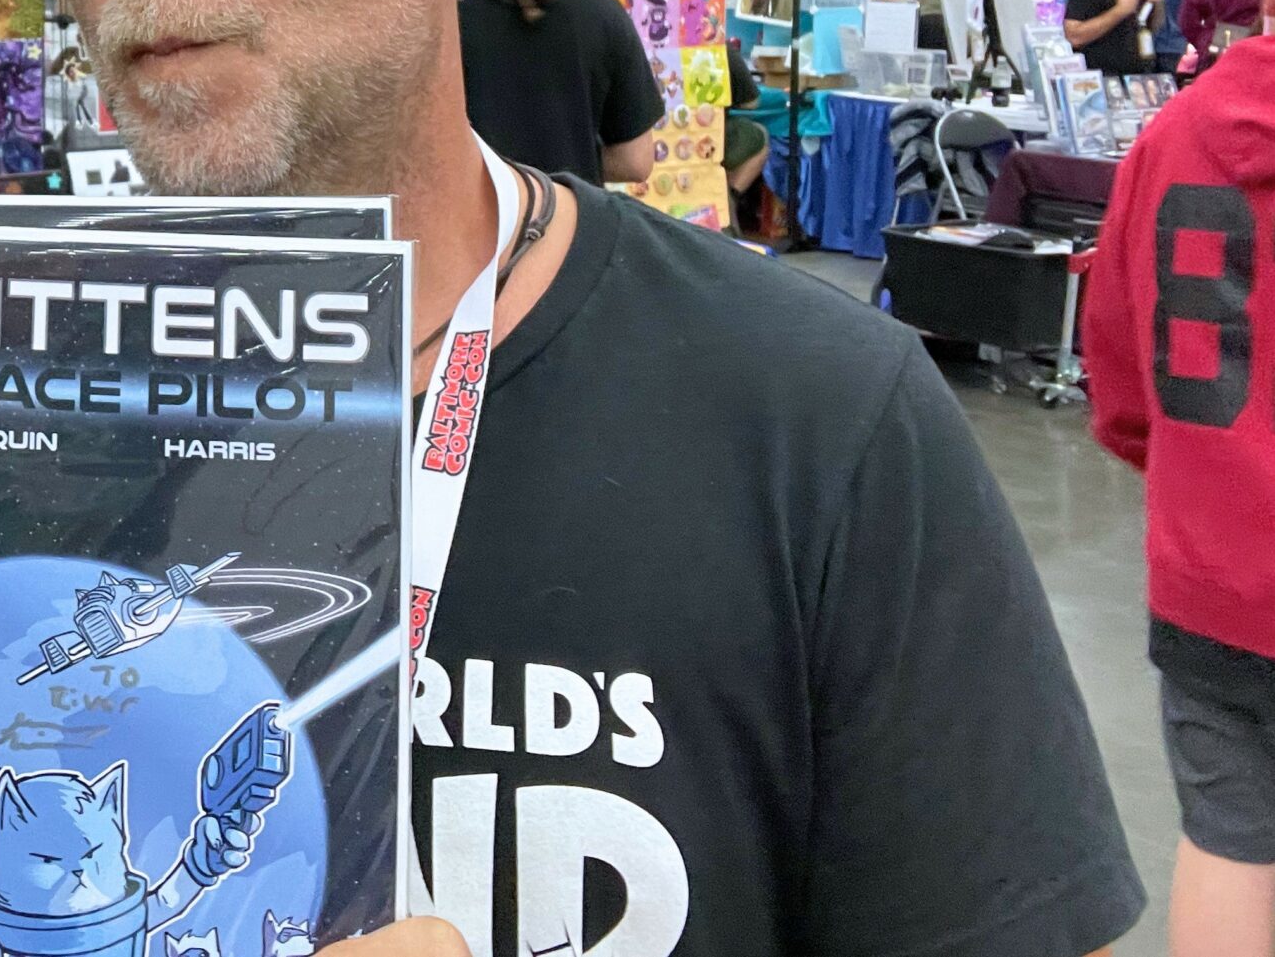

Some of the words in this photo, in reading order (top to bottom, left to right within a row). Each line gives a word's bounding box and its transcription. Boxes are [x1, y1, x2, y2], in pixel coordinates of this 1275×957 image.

[1154, 183, 1256, 429] 8
[147, 372, 353, 423] PILOT
[163, 438, 276, 461] HARRIS
